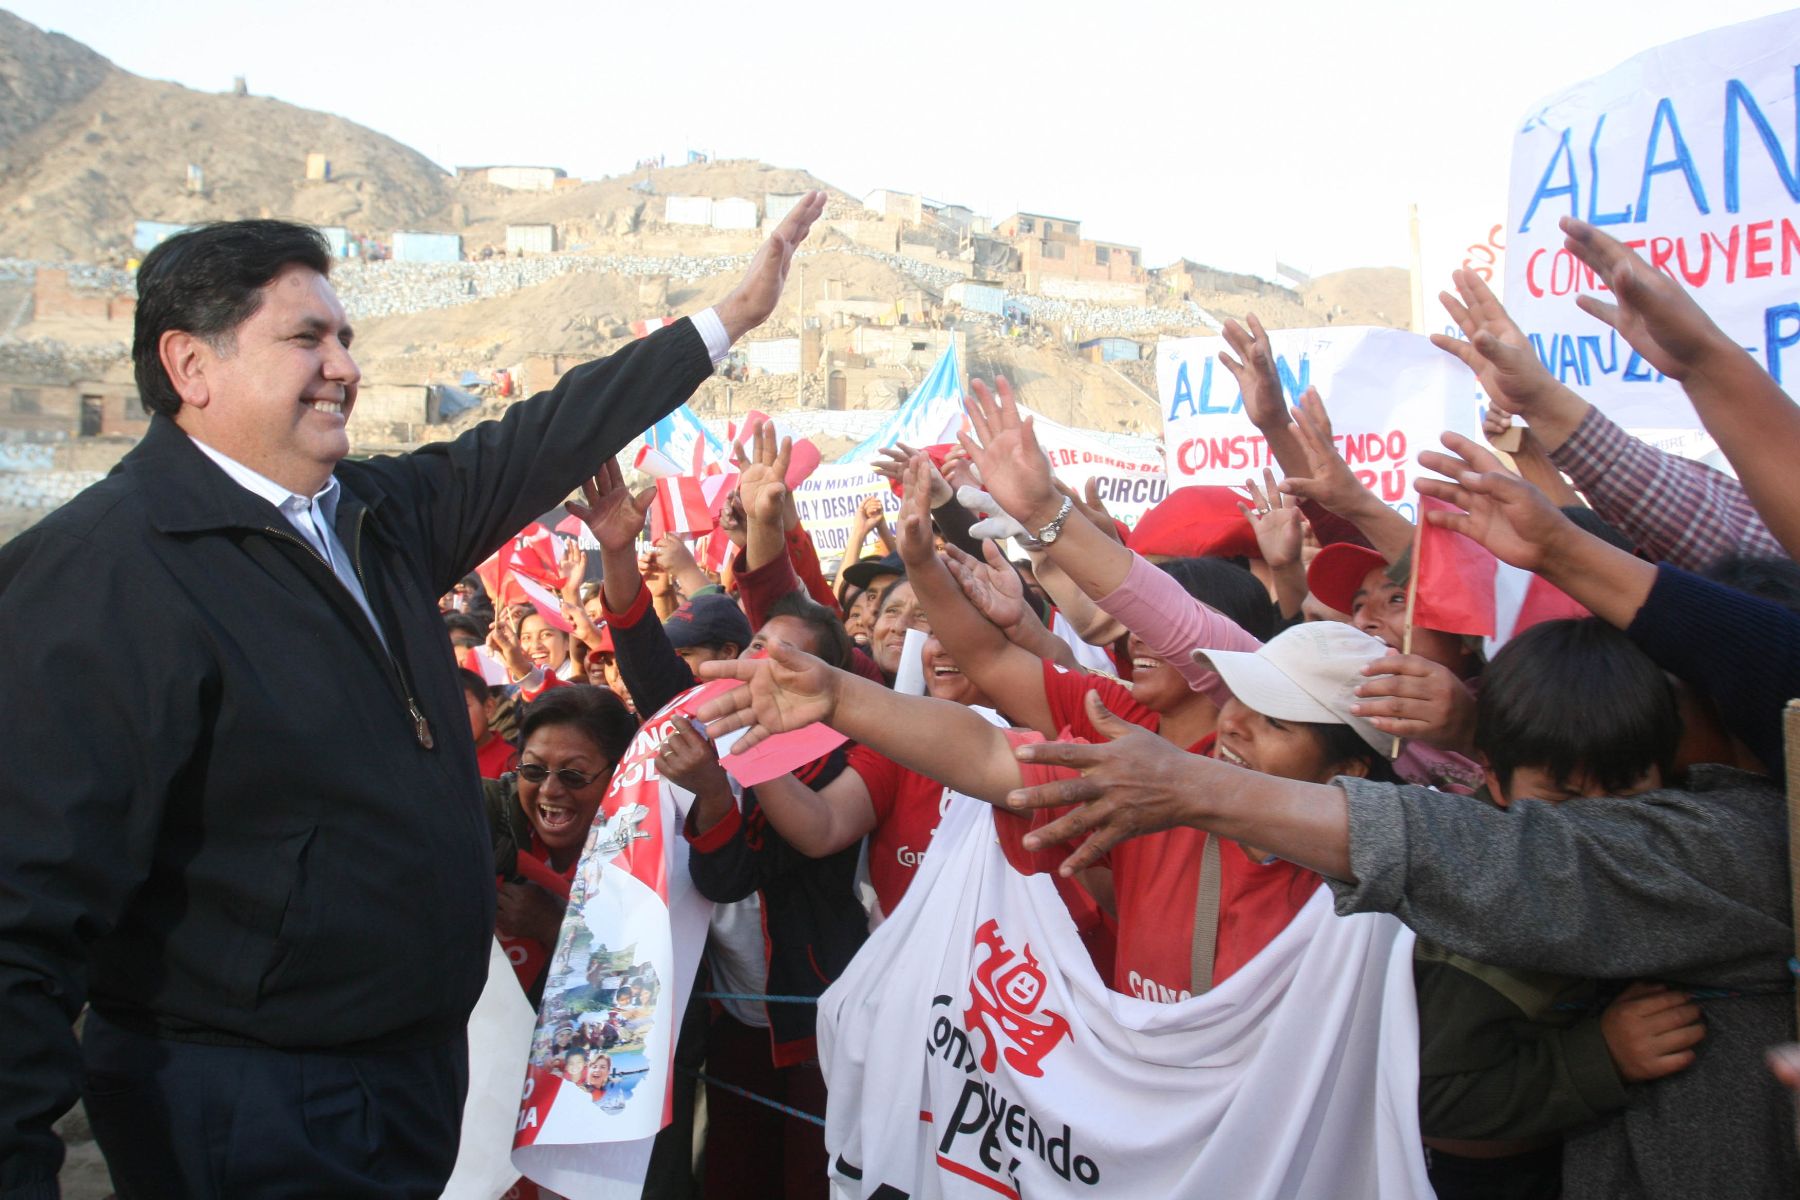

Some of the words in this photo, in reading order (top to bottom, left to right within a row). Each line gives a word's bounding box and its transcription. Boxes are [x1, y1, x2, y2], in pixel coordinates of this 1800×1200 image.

[1059, 448, 1079, 466] DE
[1096, 476, 1169, 503] CIRCU
[811, 499, 819, 520] Y
